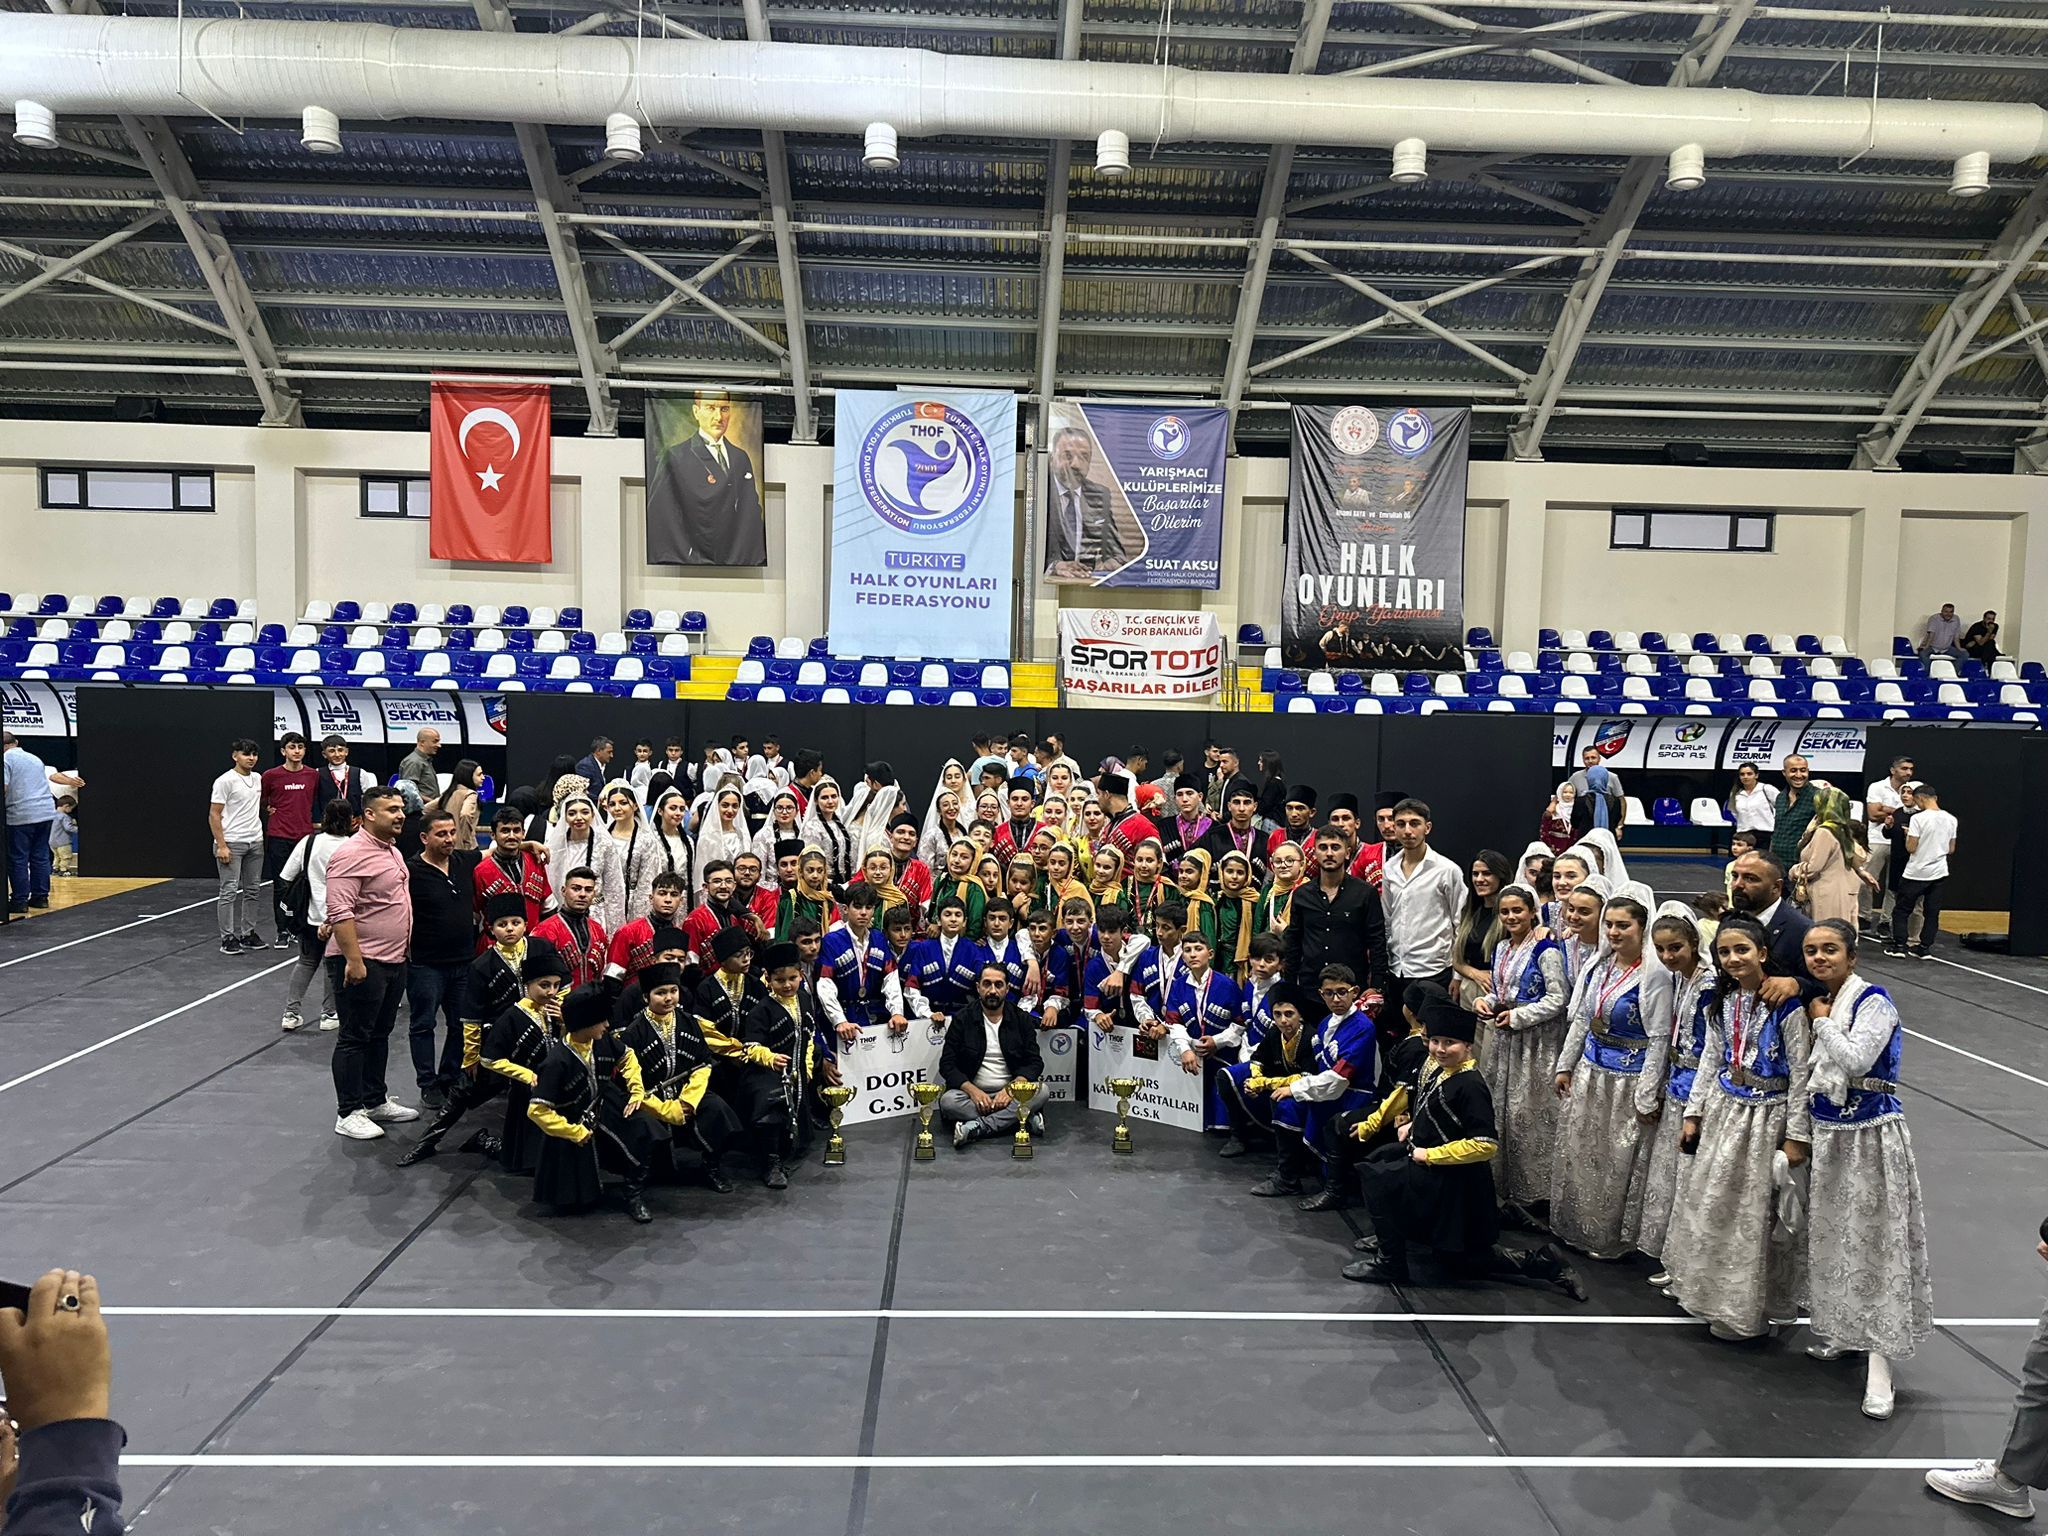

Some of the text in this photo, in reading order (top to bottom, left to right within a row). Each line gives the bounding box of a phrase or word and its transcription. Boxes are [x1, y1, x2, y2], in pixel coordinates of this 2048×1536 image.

[910, 425, 944, 437] THOF
[974, 440, 987, 463] HALK
[863, 408, 913, 527] TURKISH FOLK DANCE FEDERATION
[1139, 466, 1208, 480] YARIŞMACI
[974, 464, 988, 506] OYUNLARI
[1123, 480, 1223, 494] KULÜPLERİMİZE
[1142, 494, 1210, 513] Başarılar
[913, 505, 973, 530] FEDERASYONU
[1151, 513, 1203, 532] Dilerim
[887, 552, 962, 568] TÜRKİYE
[1145, 559, 1218, 571] SUAT AKSU
[1340, 542, 1416, 577] HALK
[850, 573, 997, 590] HALK OYUNLARI
[1299, 573, 1445, 611] OYUNLARI
[856, 592, 991, 609] FEDERASYONU
[1125, 613, 1200, 626] T.C. GENÇLİK VE
[1121, 624, 1202, 636] SPOR BAKANLIĞI
[1064, 676, 1219, 694] BAŞARILAR DİLER
[385, 702, 433, 710] MEHMET
[2, 716, 44, 724] ERZURUM
[387, 710, 458, 721] SEKMEN
[320, 724, 362, 732] ERZURUM
[1801, 739, 1866, 750] SEKMEN
[860, 1036, 877, 1044] THOF
[1109, 1033, 1124, 1042] THOF
[866, 1068, 927, 1091] DORE
[1132, 1076, 1159, 1090] KARS
[1135, 1091, 1199, 1113] KARTALLARI
[1132, 1106, 1160, 1120] G.S.K
